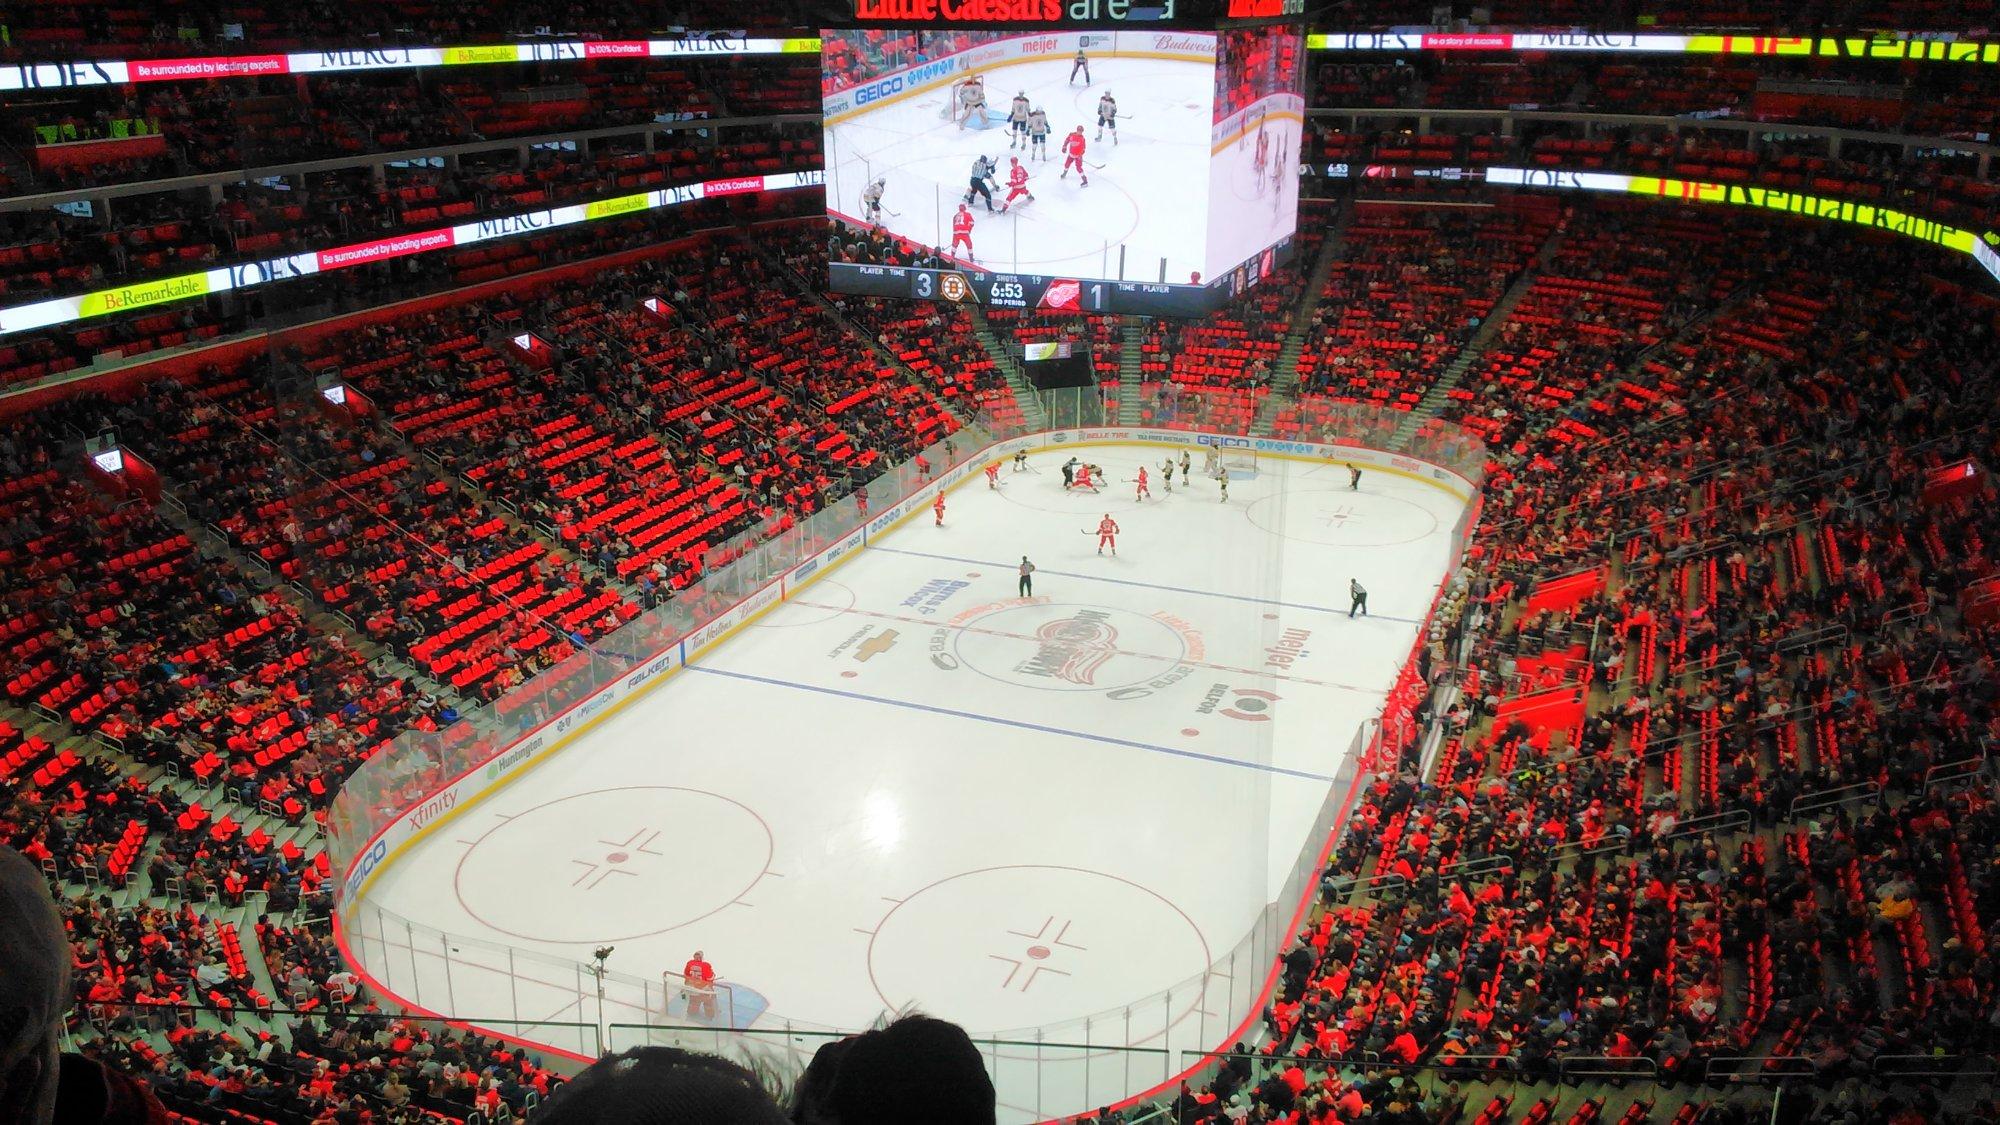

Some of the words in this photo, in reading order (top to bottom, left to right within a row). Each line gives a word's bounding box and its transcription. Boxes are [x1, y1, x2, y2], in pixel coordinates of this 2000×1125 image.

[458, 49, 513, 62] BeRemarkable
[1022, 36, 1058, 53] meijer
[138, 65, 150, 76] Be
[151, 63, 202, 75] surrounded
[203, 63, 214, 73] by
[215, 61, 249, 72] leading
[855, 77, 903, 105] GEICO
[323, 254, 333, 265] Be
[334, 246, 379, 263] surrounded
[380, 245, 390, 255] by
[391, 239, 420, 252] leading
[421, 233, 449, 247] experts.
[860, 266, 884, 275] PLAYER
[890, 268, 906, 277] TIME
[996, 275, 1018, 283] SHOTS
[1032, 276, 1042, 285] 19
[104, 278, 201, 310] BeRemarkable
[917, 273, 932, 298] 3
[991, 283, 1023, 299] 6:53
[1090, 284, 1102, 310] 1
[1118, 283, 1135, 291] TIME
[1143, 284, 1170, 294] PLAYER
[1004, 299, 1026, 307] PERIOD
[1197, 435, 1250, 448] GEICO
[1264, 628, 1311, 670] meijer
[627, 655, 669, 690] FALKEN
[498, 736, 543, 772] Huntington
[409, 787, 459, 831] xfinity
[345, 839, 387, 900] GEICO
